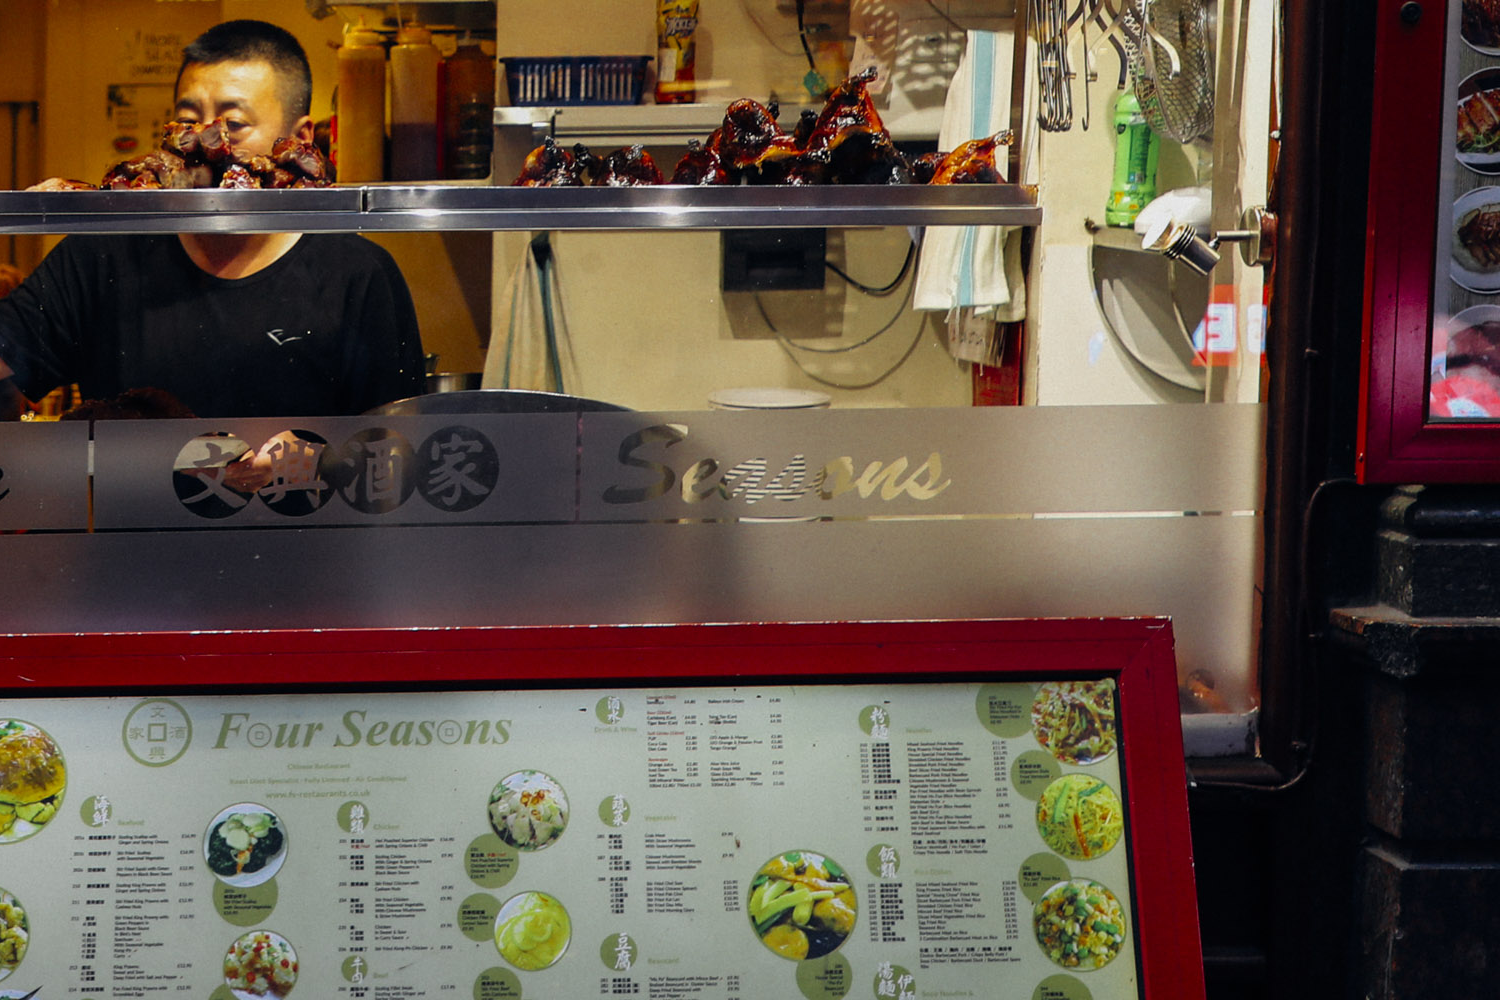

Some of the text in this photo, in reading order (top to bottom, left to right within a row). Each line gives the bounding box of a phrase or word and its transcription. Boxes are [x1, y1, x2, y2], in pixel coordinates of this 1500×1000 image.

[601, 423, 953, 505] Seasons
[211, 709, 513, 750] Four Seasons
[614, 932, 632, 971] 豆腐
